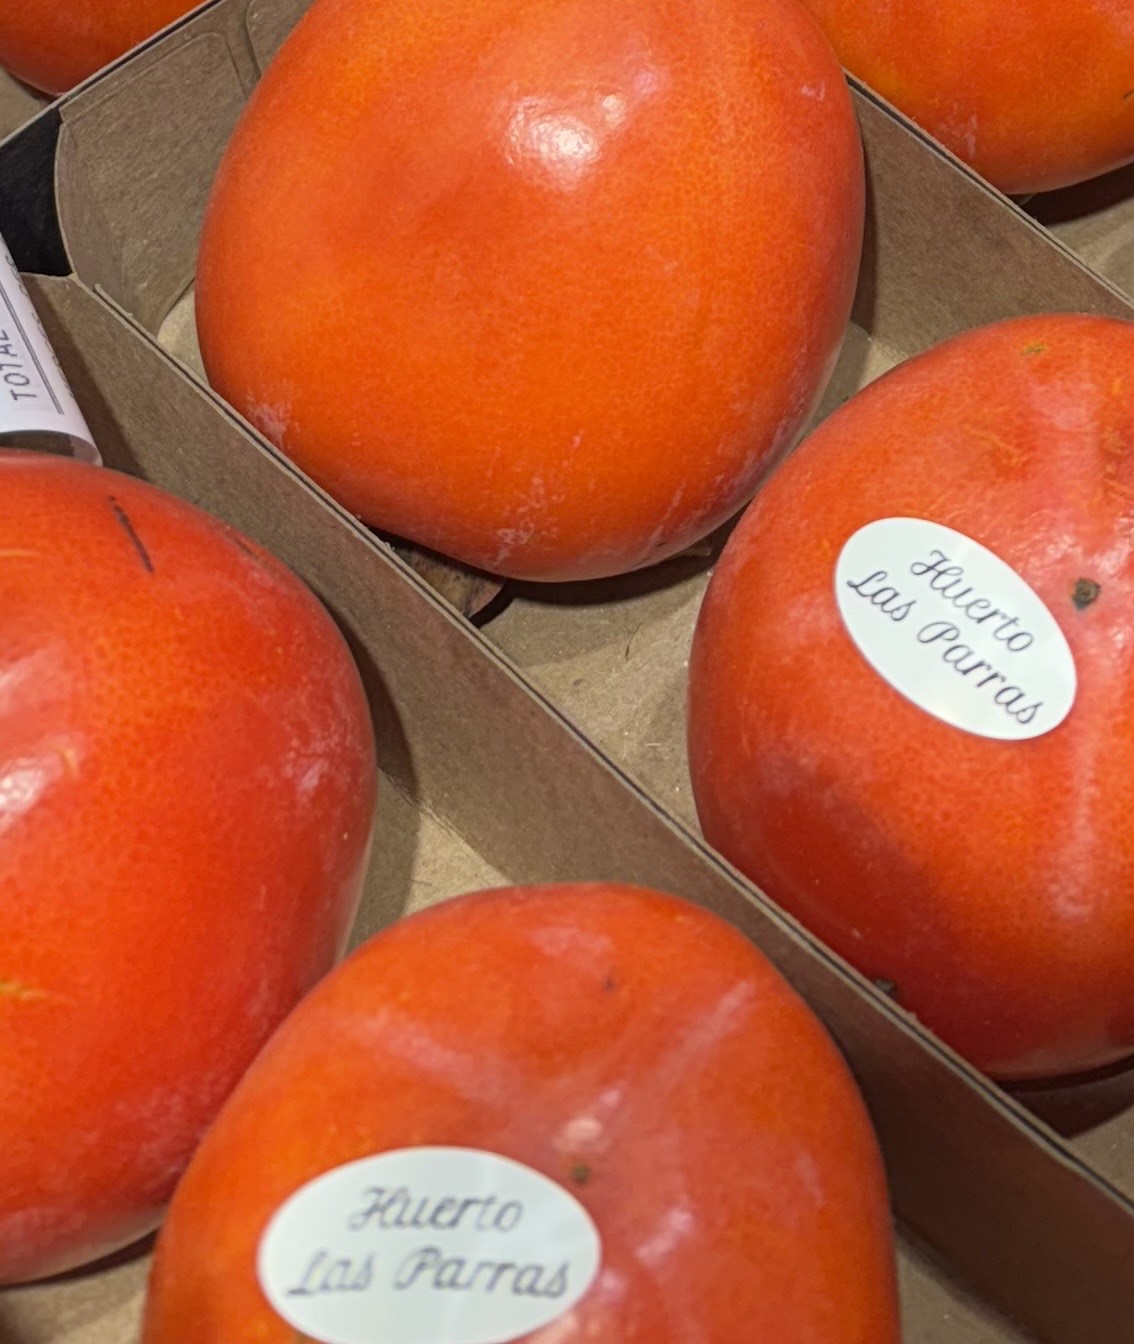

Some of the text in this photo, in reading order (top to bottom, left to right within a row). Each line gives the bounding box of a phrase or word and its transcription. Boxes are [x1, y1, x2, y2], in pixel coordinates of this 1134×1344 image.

[910, 549, 1033, 652] Huerto
[846, 571, 1044, 724] Las Parras
[348, 1186, 525, 1232] Huerto
[285, 1246, 571, 1300] Las Parras
